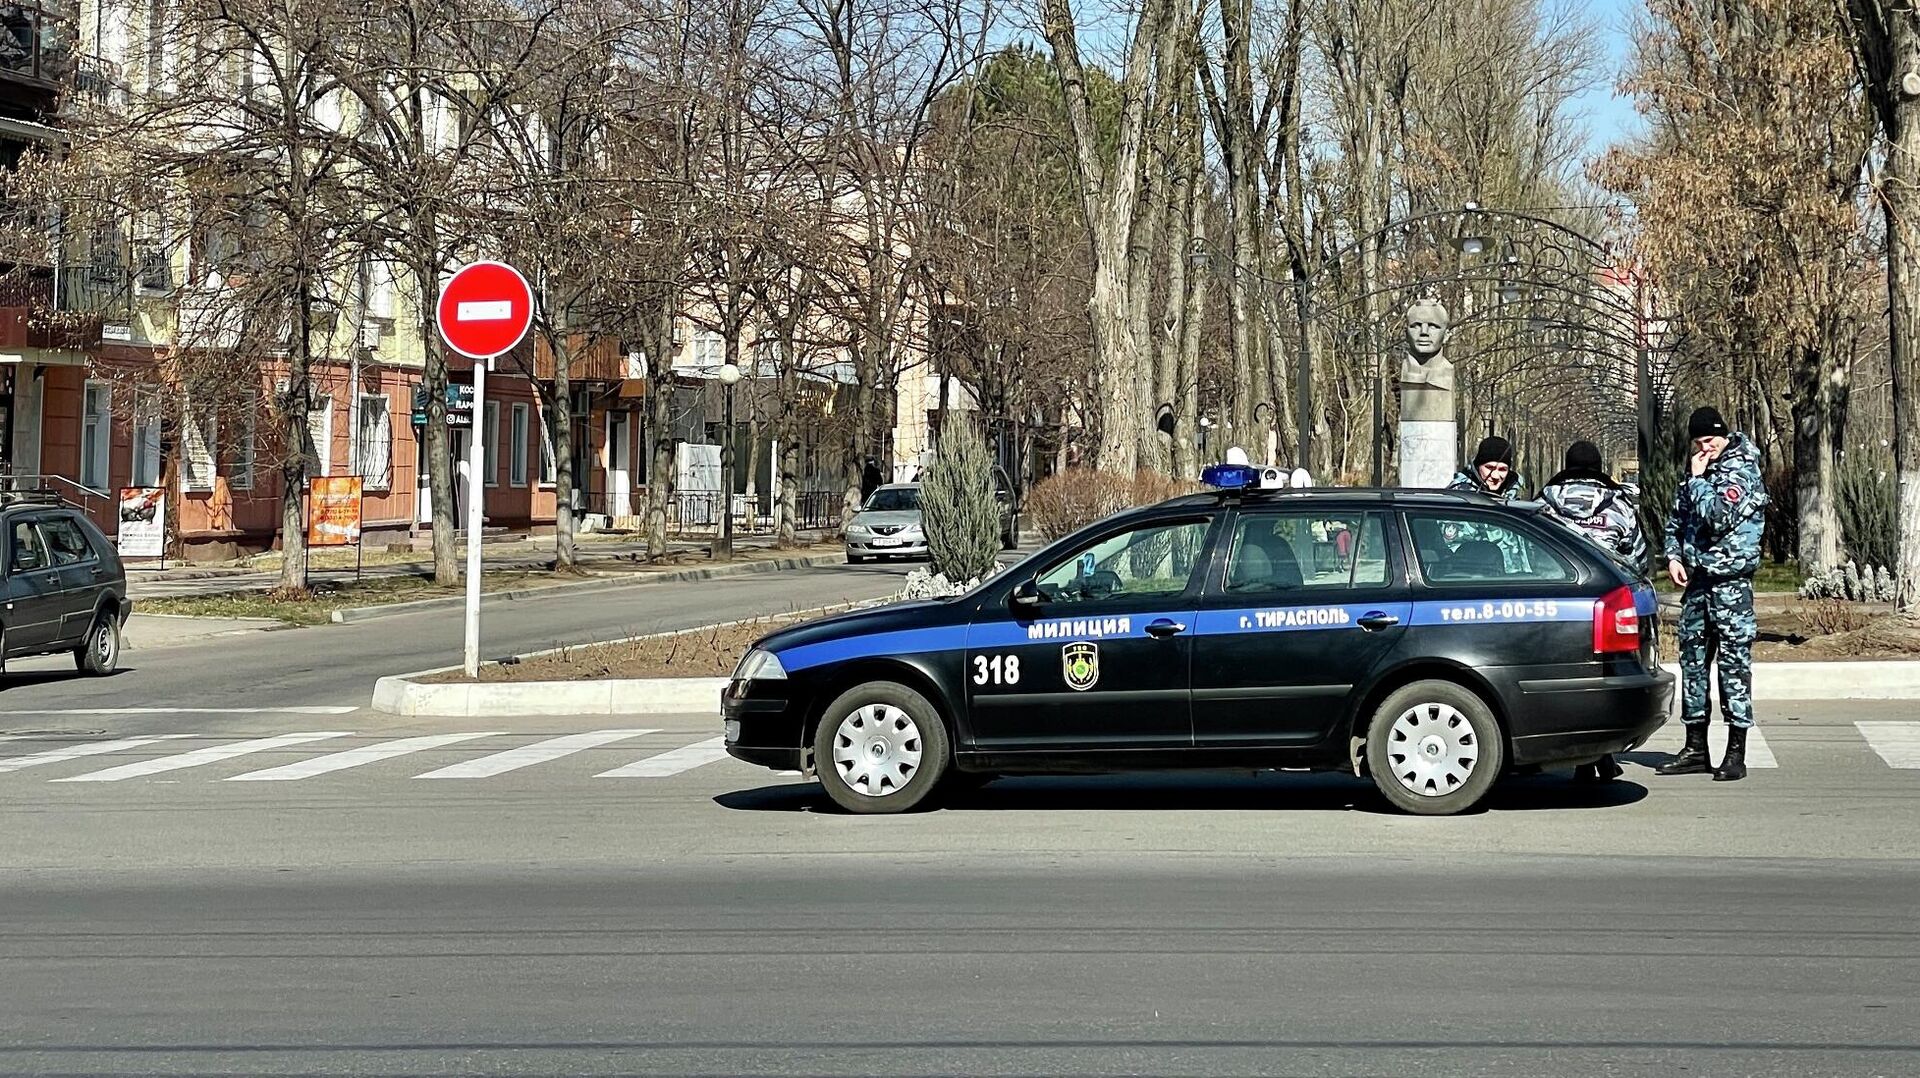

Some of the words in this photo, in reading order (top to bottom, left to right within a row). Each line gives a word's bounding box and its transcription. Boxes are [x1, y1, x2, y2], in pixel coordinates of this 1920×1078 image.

[1027, 617, 1131, 639] МИЛИЦИЯ
[1239, 616, 1252, 629] г.
[1255, 608, 1350, 628] ТИРАСПОЛЬ
[973, 655, 1020, 685] 318
